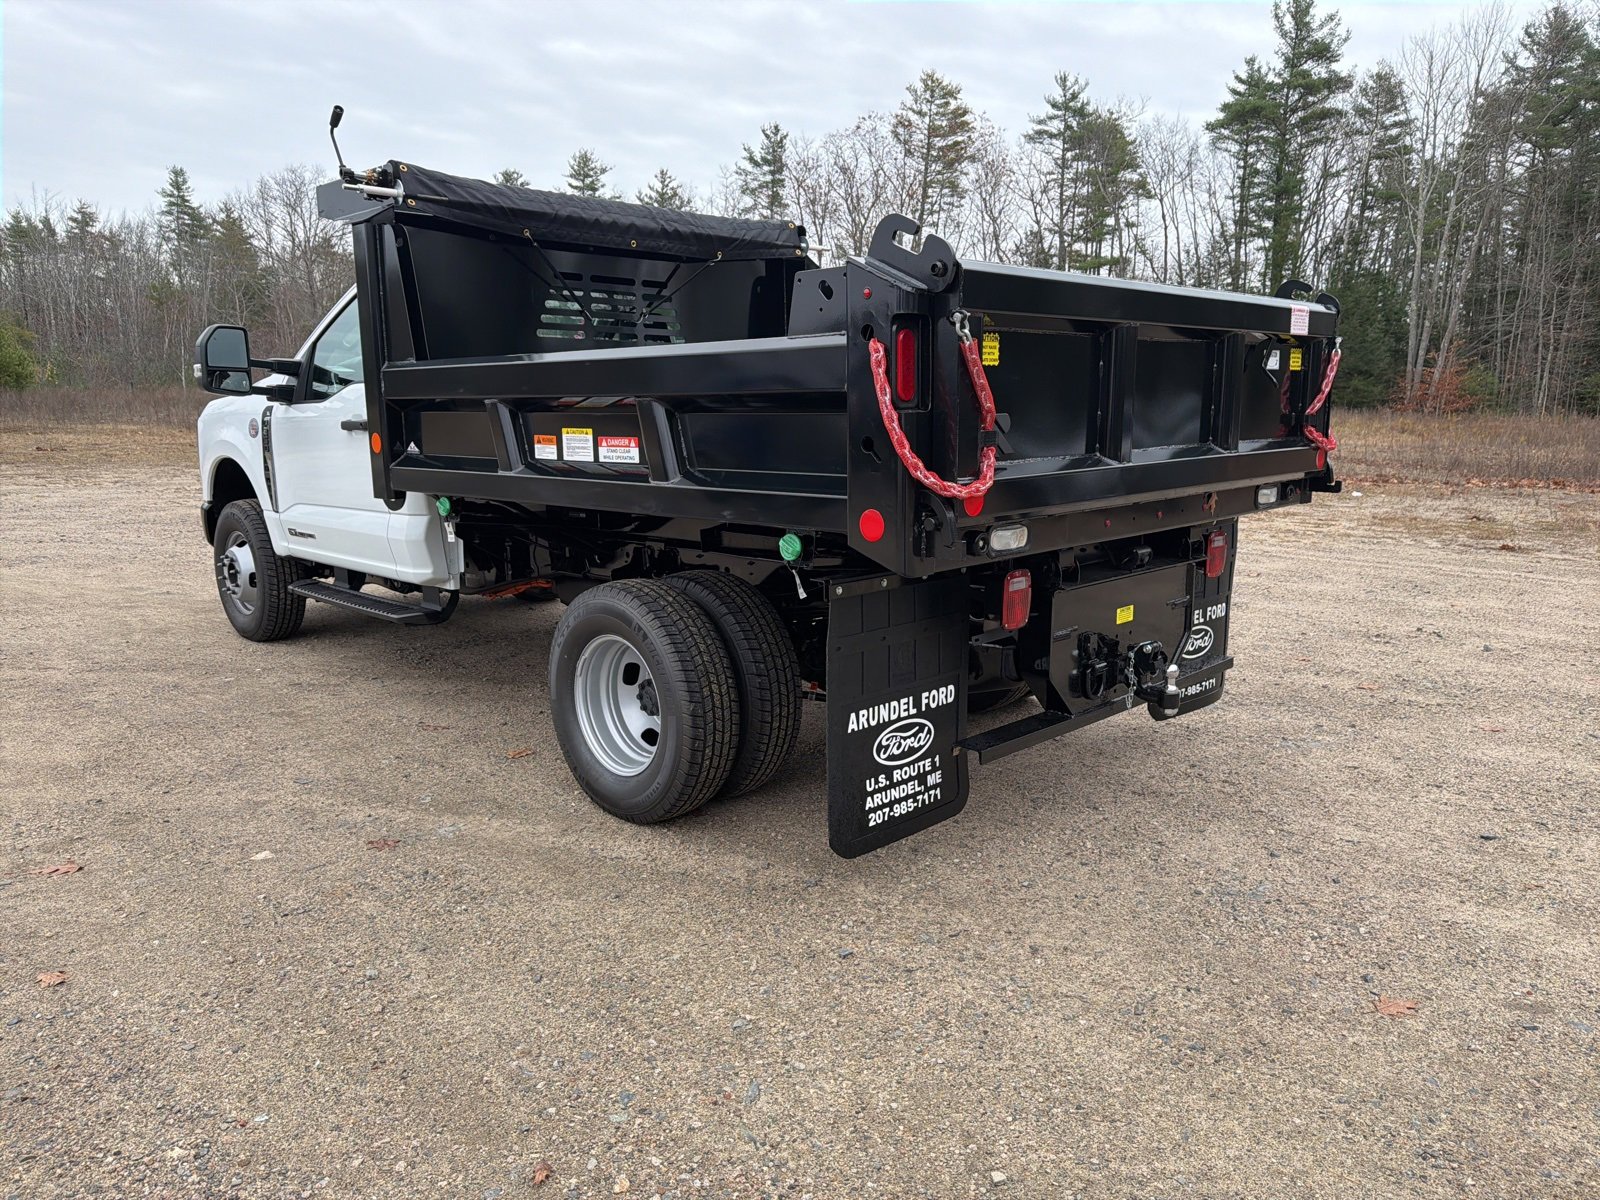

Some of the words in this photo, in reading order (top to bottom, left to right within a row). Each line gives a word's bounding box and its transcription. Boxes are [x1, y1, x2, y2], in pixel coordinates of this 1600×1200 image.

[607, 438, 629, 446] DANGER
[1206, 602, 1226, 621] FORD
[847, 695, 917, 733] ARUNDEL
[921, 684, 955, 711] FORD
[879, 725, 930, 760] Ford
[865, 774, 890, 792] U.S.
[893, 757, 932, 783] ROUTE
[935, 754, 940, 767] 1
[865, 779, 925, 811] ARUNDEL,
[927, 770, 942, 787] ME
[868, 787, 941, 827] 207-985-7171
